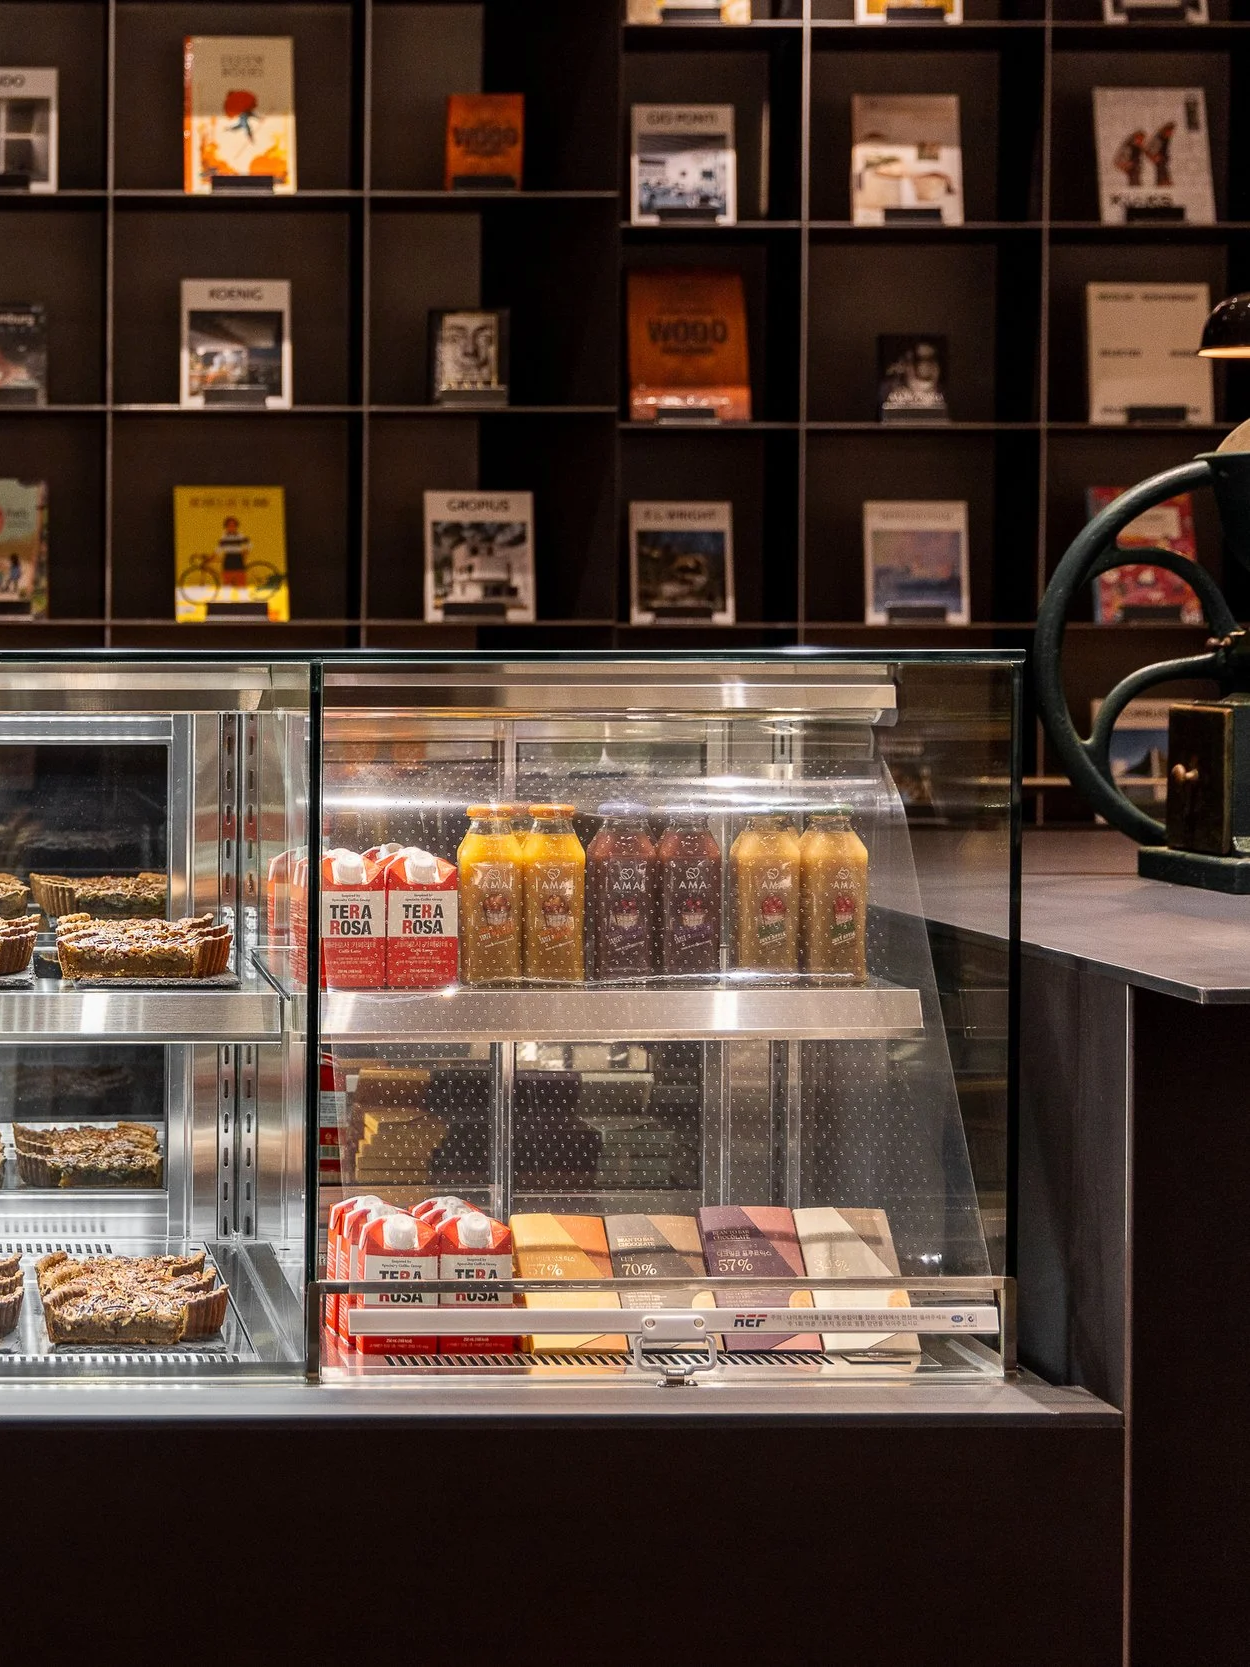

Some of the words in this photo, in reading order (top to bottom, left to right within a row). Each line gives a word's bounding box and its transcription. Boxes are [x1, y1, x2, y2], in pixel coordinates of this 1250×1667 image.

[646, 111, 671, 125] GIO
[208, 287, 263, 301] KOENIG
[648, 318, 728, 344] WOOD
[445, 498, 510, 512] GROPIUS
[667, 510, 716, 521] WRIGHT
[613, 881, 641, 890] AMA
[678, 880, 707, 889] AMA
[330, 904, 372, 919] TERA
[402, 904, 444, 919] TERA
[330, 920, 372, 935] ROSA
[402, 919, 444, 935] ROSA
[526, 1263, 563, 1276] 57%
[621, 1263, 657, 1275] 70%
[718, 1258, 753, 1272] 57%
